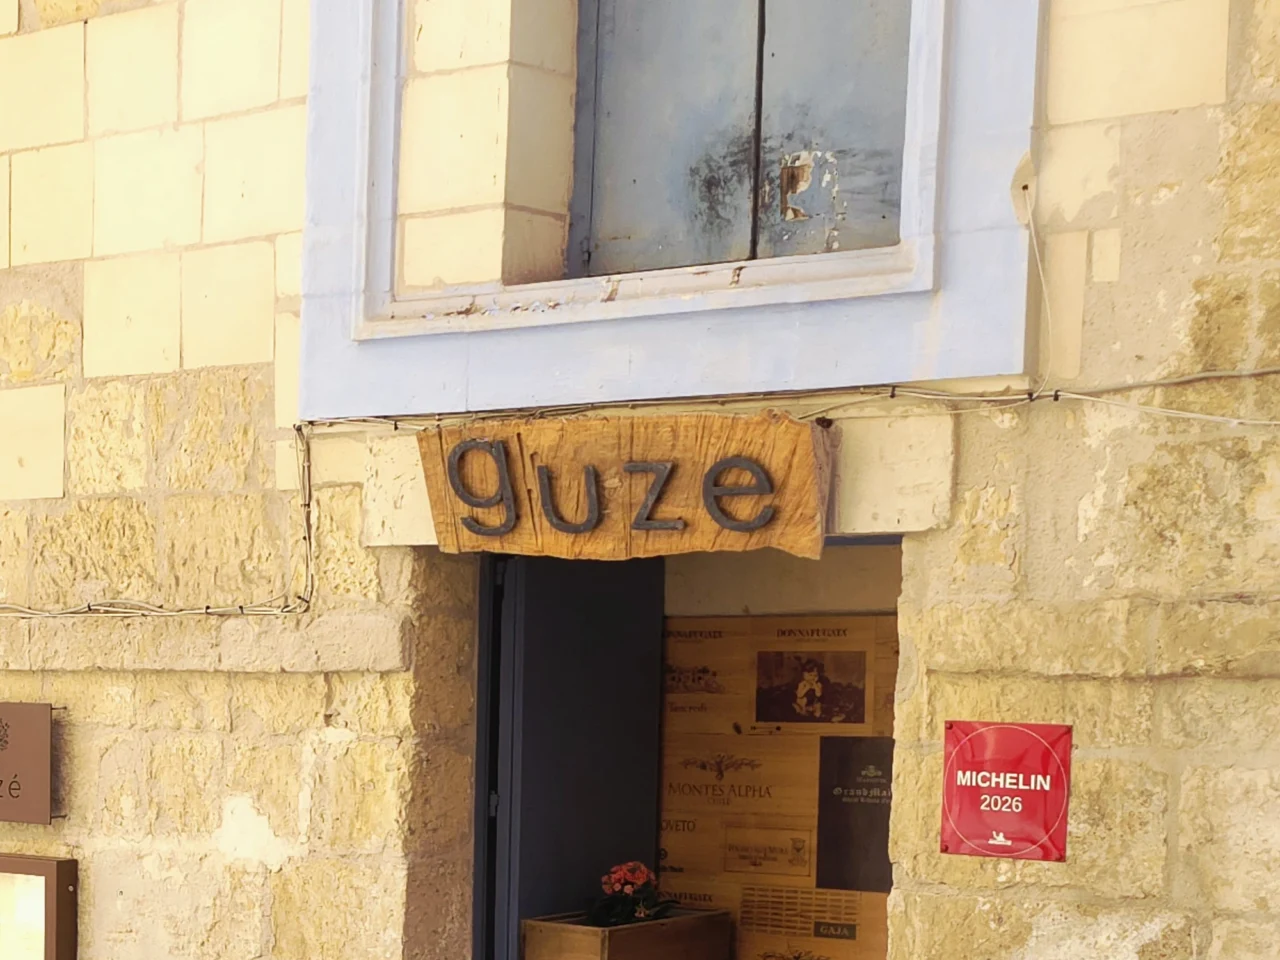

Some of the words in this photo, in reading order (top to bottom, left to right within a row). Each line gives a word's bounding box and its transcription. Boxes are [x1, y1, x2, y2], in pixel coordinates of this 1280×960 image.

[447, 437, 775, 537] guze
[956, 770, 1051, 791] MICHELIN
[667, 782, 725, 797] MONTES
[727, 784, 772, 799] ALPHA
[980, 795, 1022, 812] 2026
[660, 819, 696, 832] OVETO
[819, 925, 849, 936] GAJA
